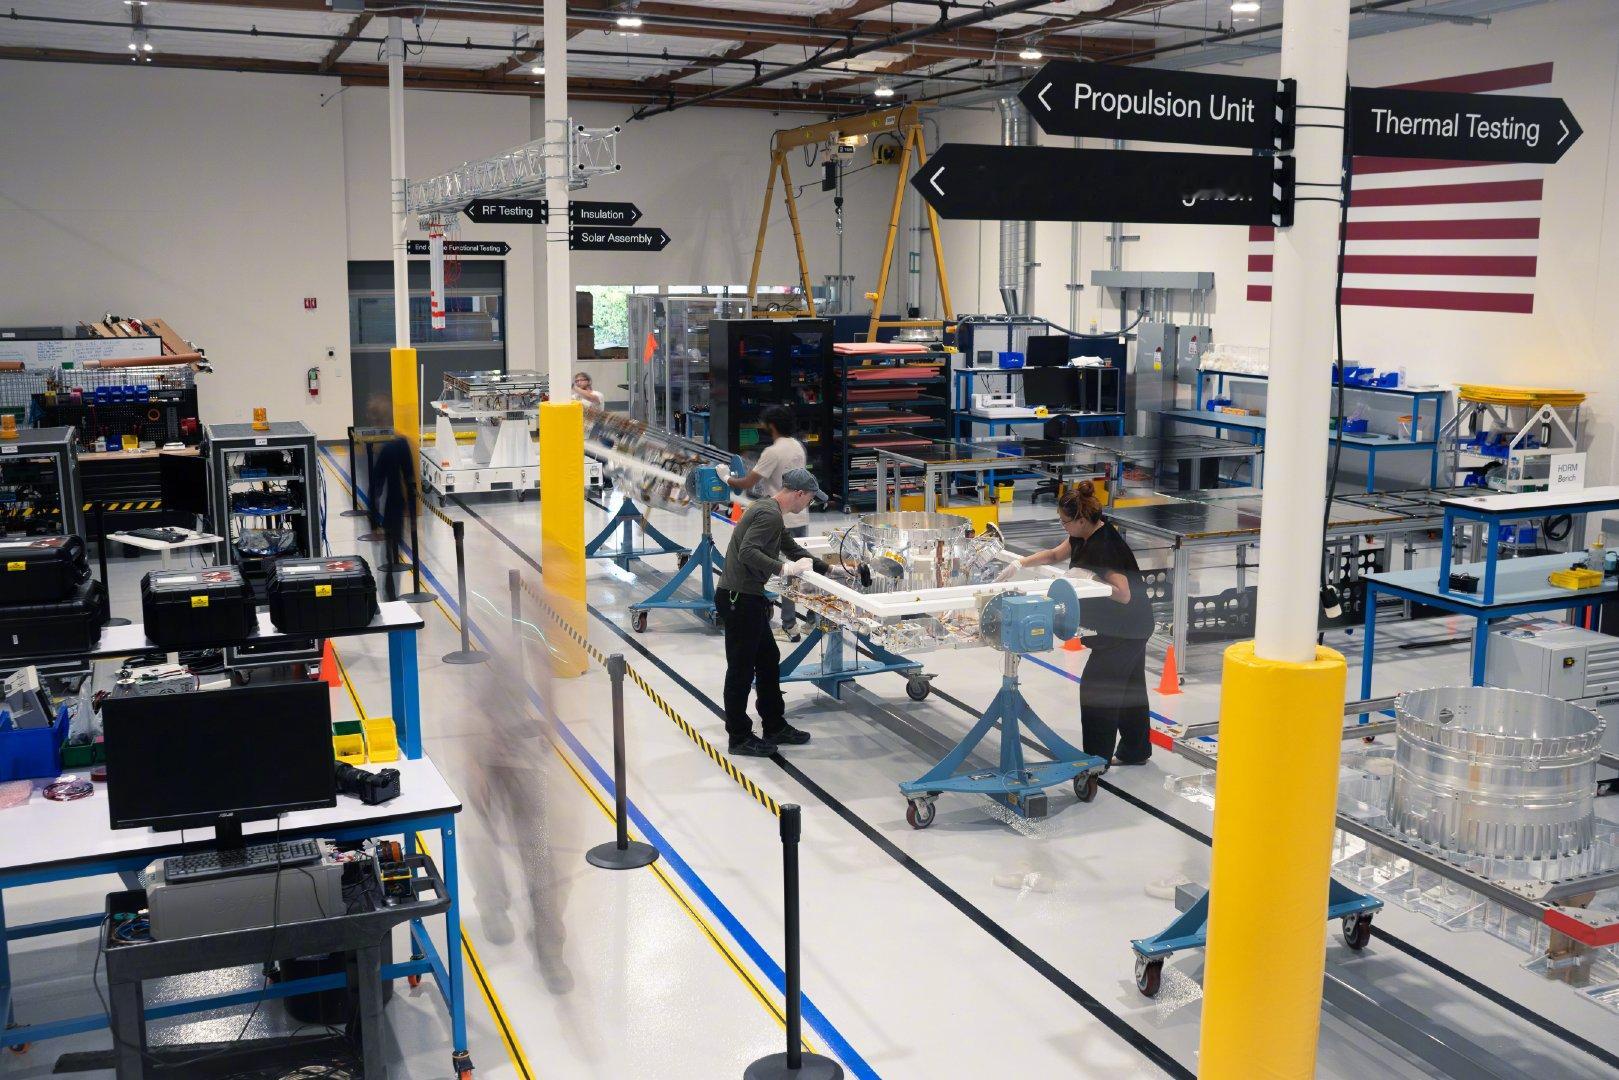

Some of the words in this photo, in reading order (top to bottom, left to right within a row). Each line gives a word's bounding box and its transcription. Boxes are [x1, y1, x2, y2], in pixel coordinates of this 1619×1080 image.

[1074, 82, 1200, 119] Propulsion
[1209, 94, 1255, 123] Unit
[1371, 108, 1459, 138] Thermal
[1465, 113, 1540, 147] Testing
[482, 205, 497, 215] RF
[499, 206, 533, 218] Testing
[581, 209, 624, 219] Insulation
[581, 232, 605, 242] Solar
[608, 233, 653, 245] Assembly
[448, 244, 479, 252] Functional
[480, 245, 501, 253] Testing
[1558, 463, 1578, 472] HDRM
[1558, 474, 1577, 482] Bench
